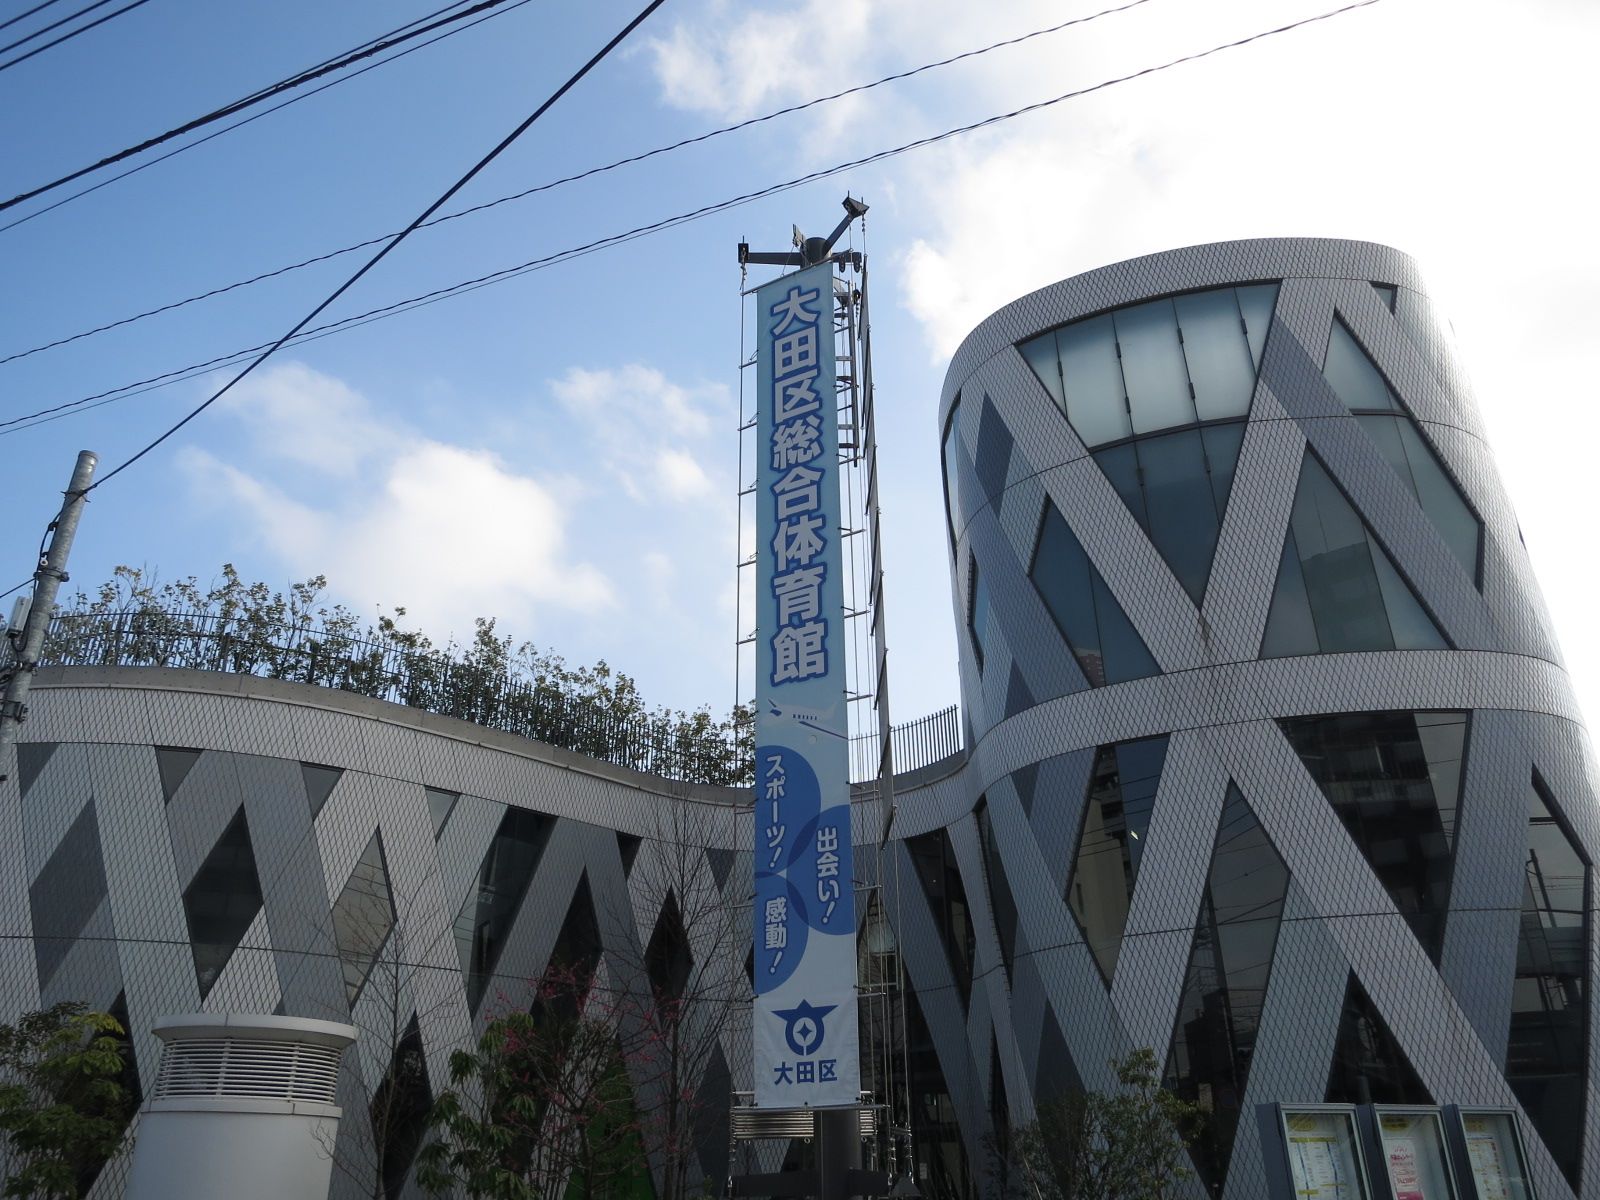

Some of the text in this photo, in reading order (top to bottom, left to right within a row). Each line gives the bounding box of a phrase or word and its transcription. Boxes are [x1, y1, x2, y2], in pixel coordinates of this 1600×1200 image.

[771, 287, 828, 685] 大田区総合体育館
[773, 1059, 838, 1086] 大田区
